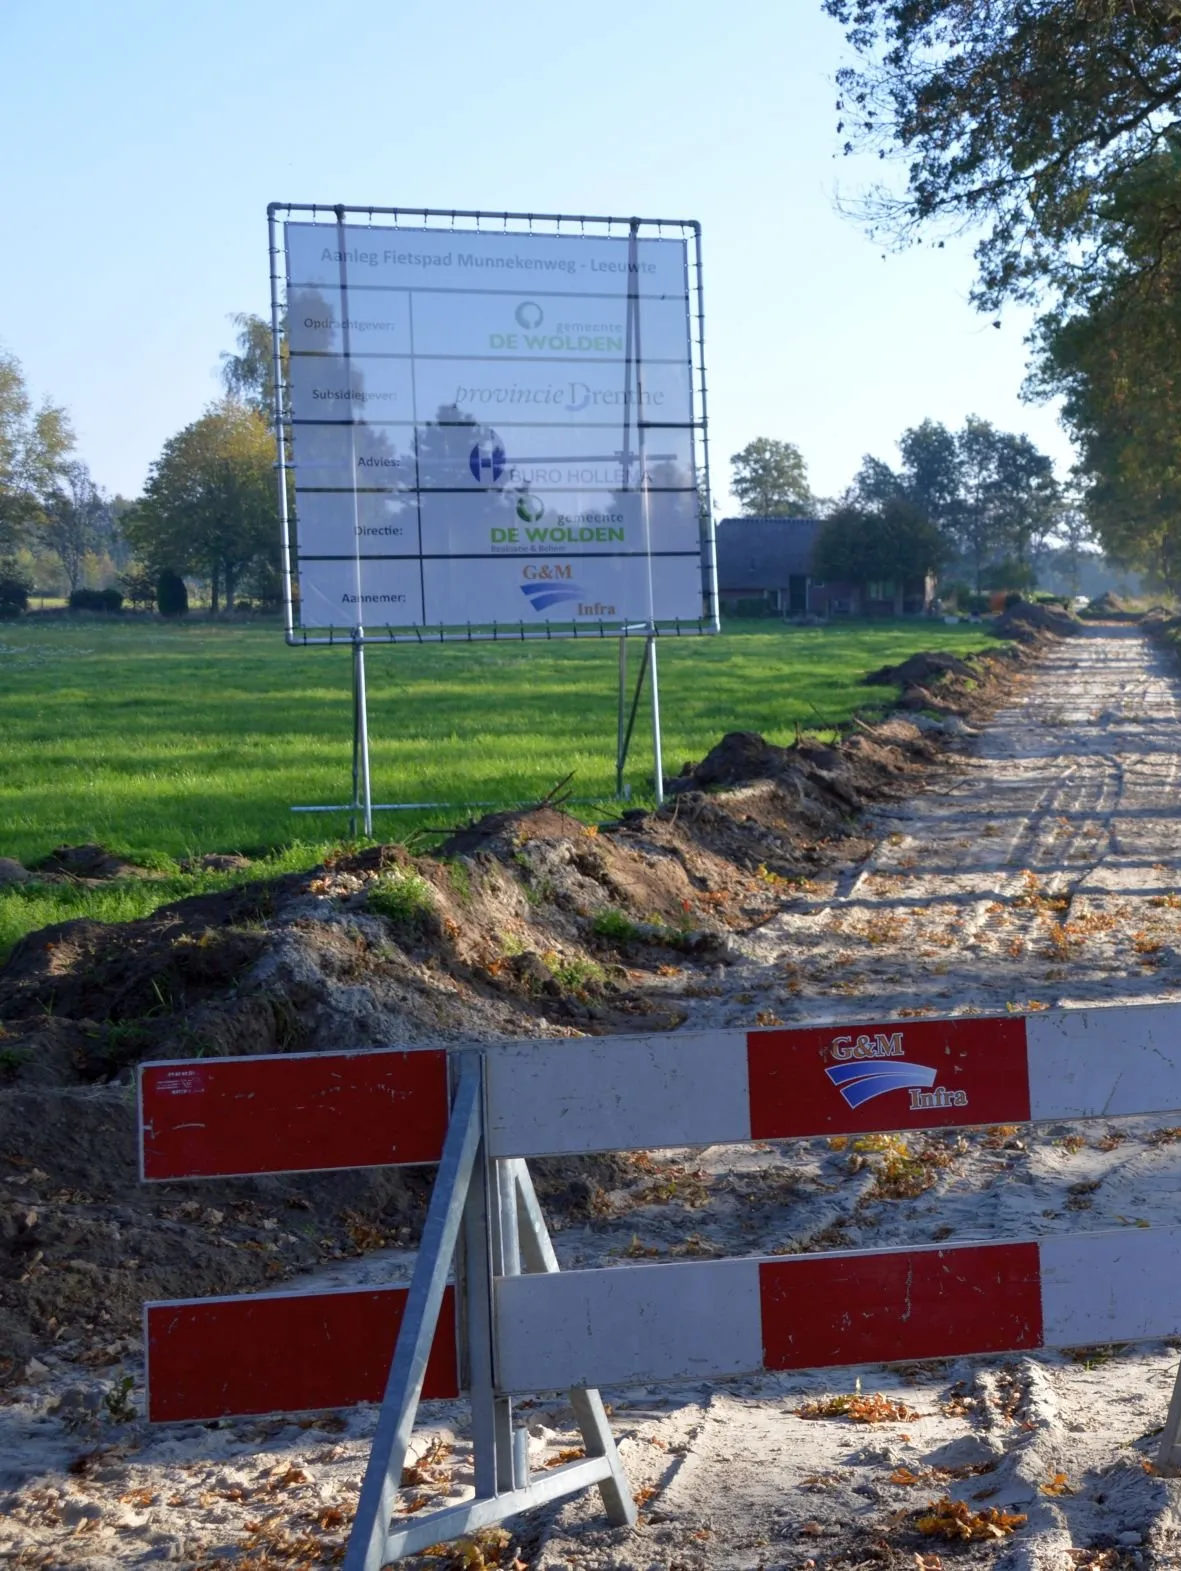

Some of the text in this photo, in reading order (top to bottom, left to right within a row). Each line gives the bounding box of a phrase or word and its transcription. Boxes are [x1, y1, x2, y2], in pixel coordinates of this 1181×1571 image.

[320, 248, 379, 266] Aanleg
[383, 249, 452, 269] Fietspad
[457, 252, 576, 273] Munnekenweg
[590, 258, 657, 274] Leeuwte
[303, 317, 396, 332] Opdrachtgever:
[556, 321, 623, 334] gemeente
[489, 333, 623, 351] DE WOLDEN
[455, 381, 664, 411] provincie Drenthe
[358, 456, 400, 468] Advies:
[557, 512, 624, 526] gemeente
[354, 525, 403, 536] Directie:
[490, 527, 625, 543] DE WOLDEN
[523, 564, 573, 580] G&M
[341, 593, 406, 604] Aannemer:
[577, 602, 616, 616] Infra
[830, 1032, 904, 1061] G&M
[908, 1086, 969, 1111] Infra
